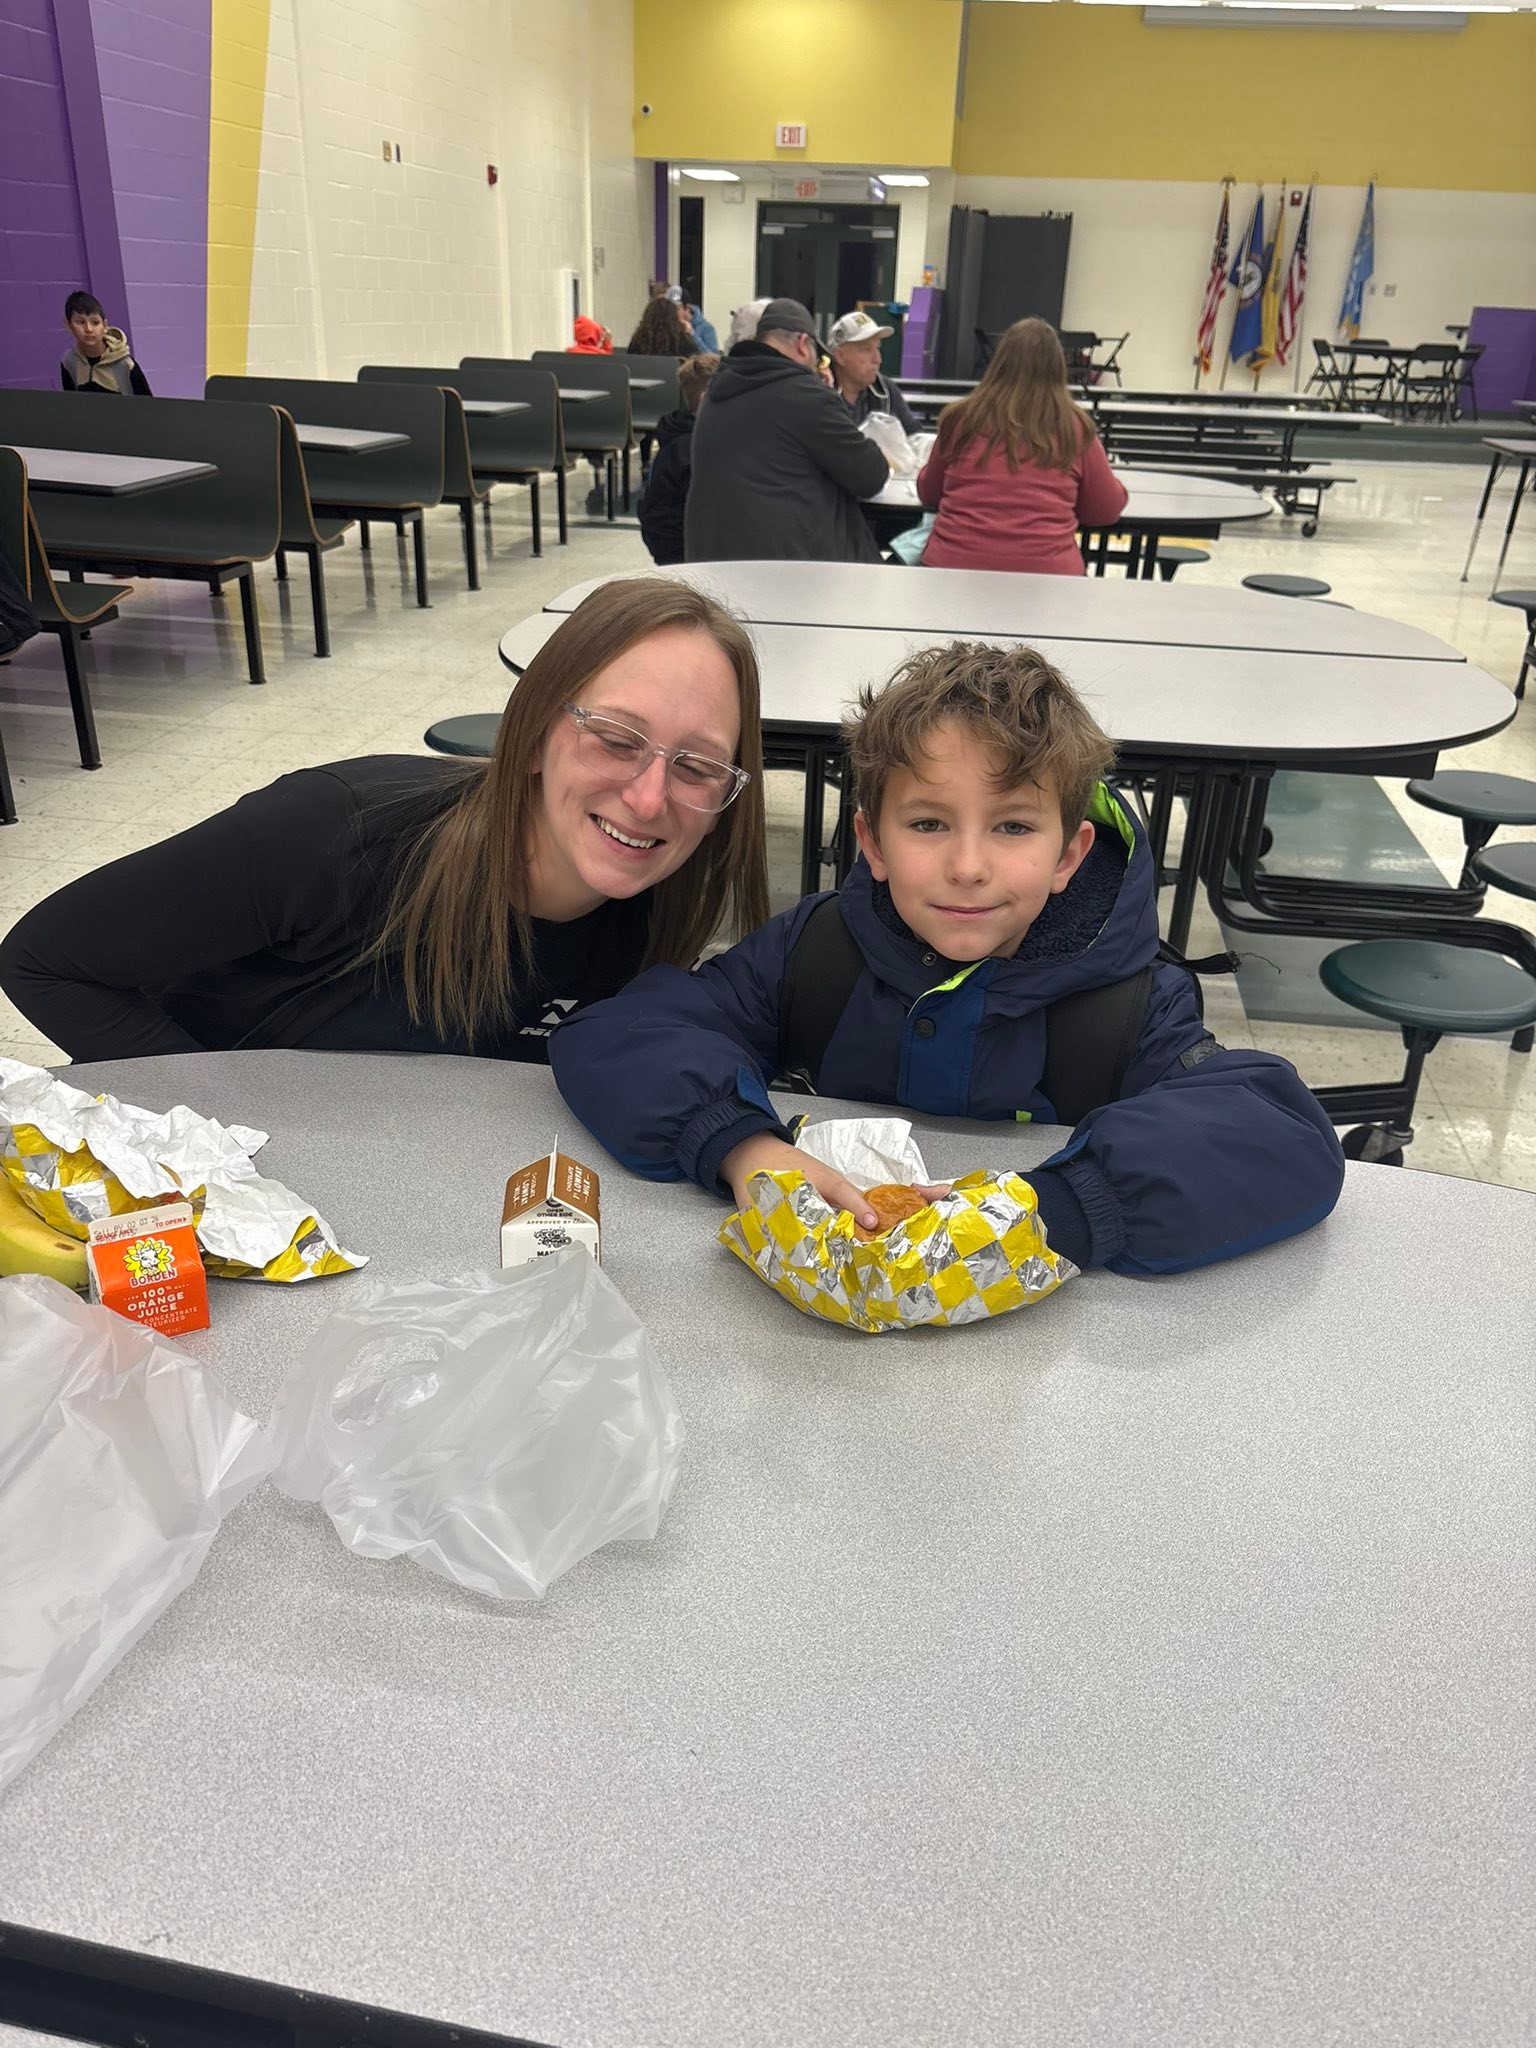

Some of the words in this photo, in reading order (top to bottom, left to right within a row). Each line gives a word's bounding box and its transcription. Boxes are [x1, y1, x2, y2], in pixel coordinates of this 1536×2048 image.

[781, 127, 801, 144] EXIT
[573, 1165, 583, 1193] LOWFAT
[582, 1178, 590, 1197] MILK
[165, 1217, 182, 1226] OPEN
[131, 1269, 176, 1287] BORDEN
[127, 1291, 185, 1312] ORANGE
[137, 1303, 177, 1319] JUICE
[144, 1306, 197, 1325] CONCENTRATE
